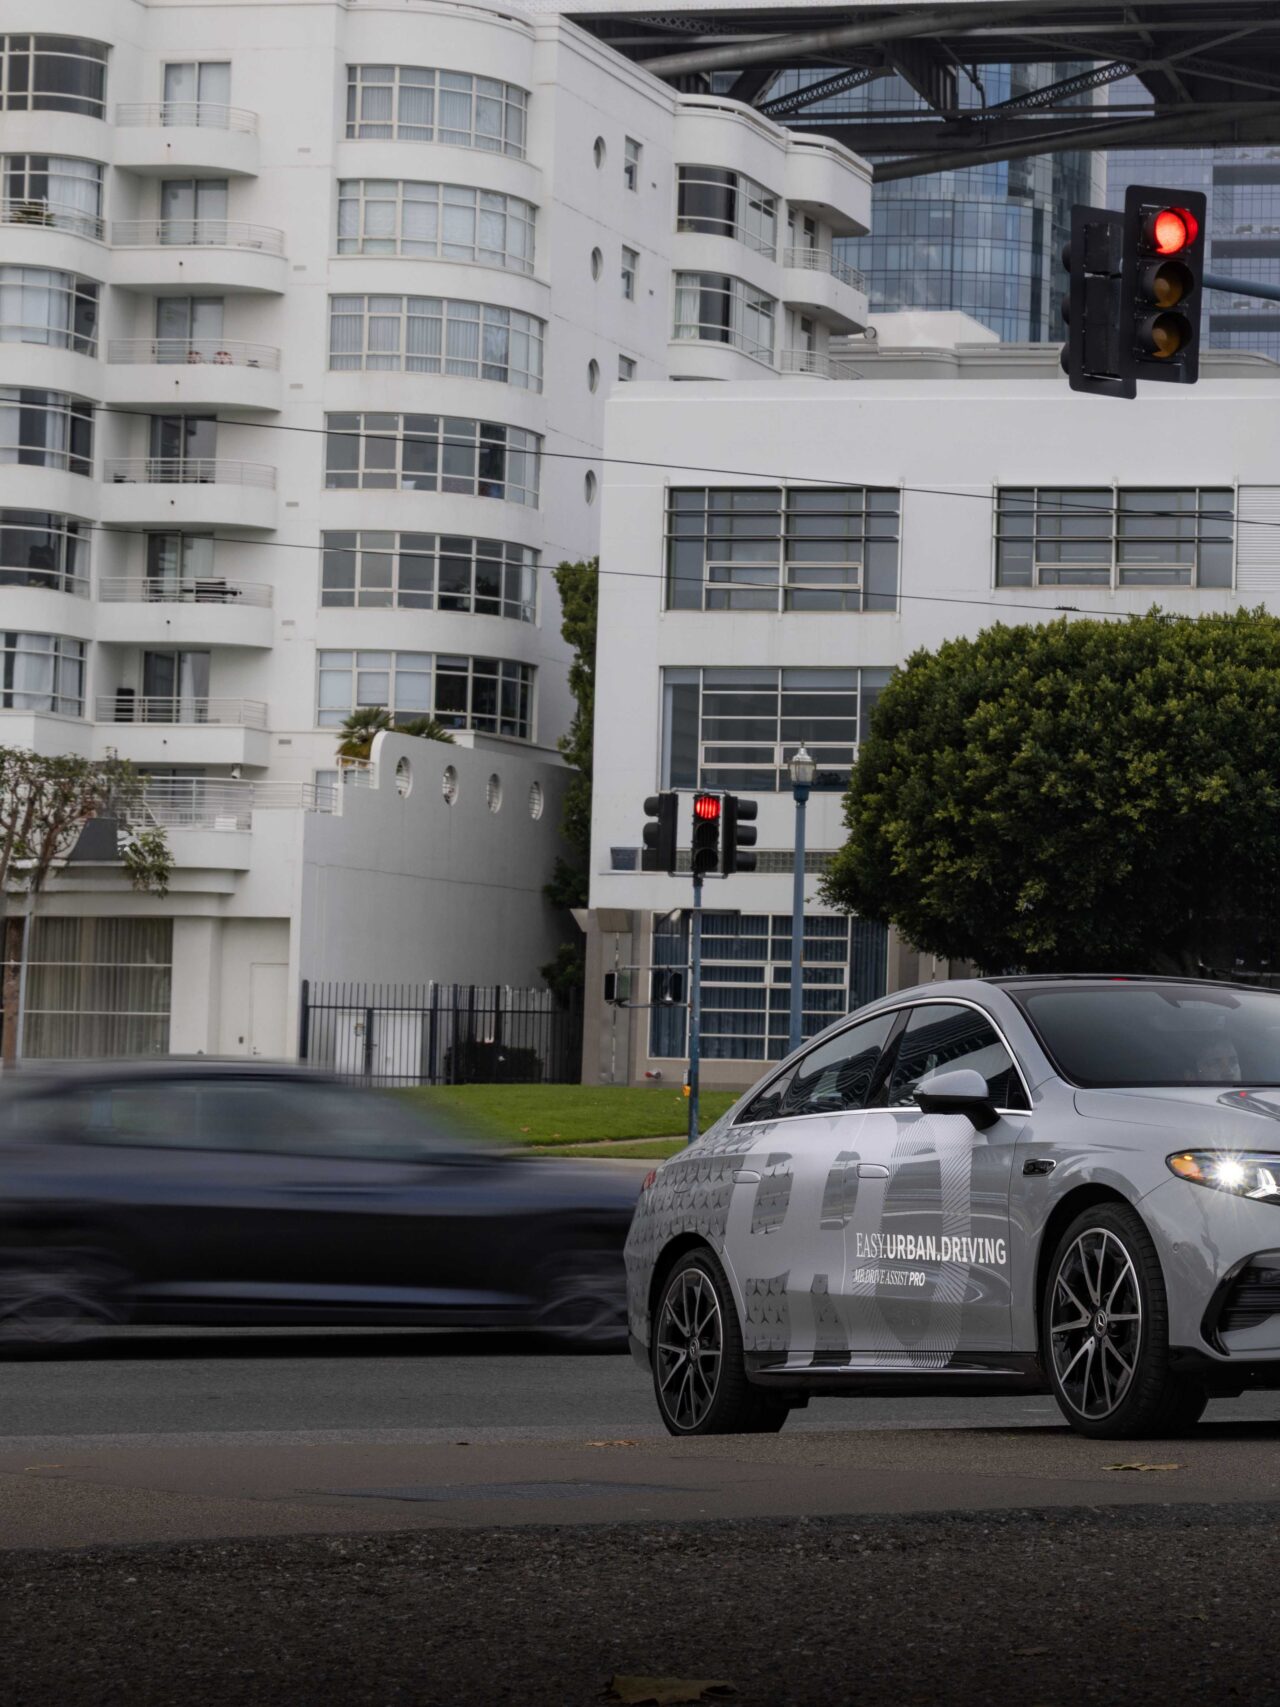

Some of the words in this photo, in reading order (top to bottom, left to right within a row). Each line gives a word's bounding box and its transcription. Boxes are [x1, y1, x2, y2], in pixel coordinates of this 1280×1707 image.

[855, 1233, 1007, 1264] EASY.URBAN.DRIVING
[885, 1271, 909, 1286] ASSIST
[908, 1272, 926, 1287] PRO
